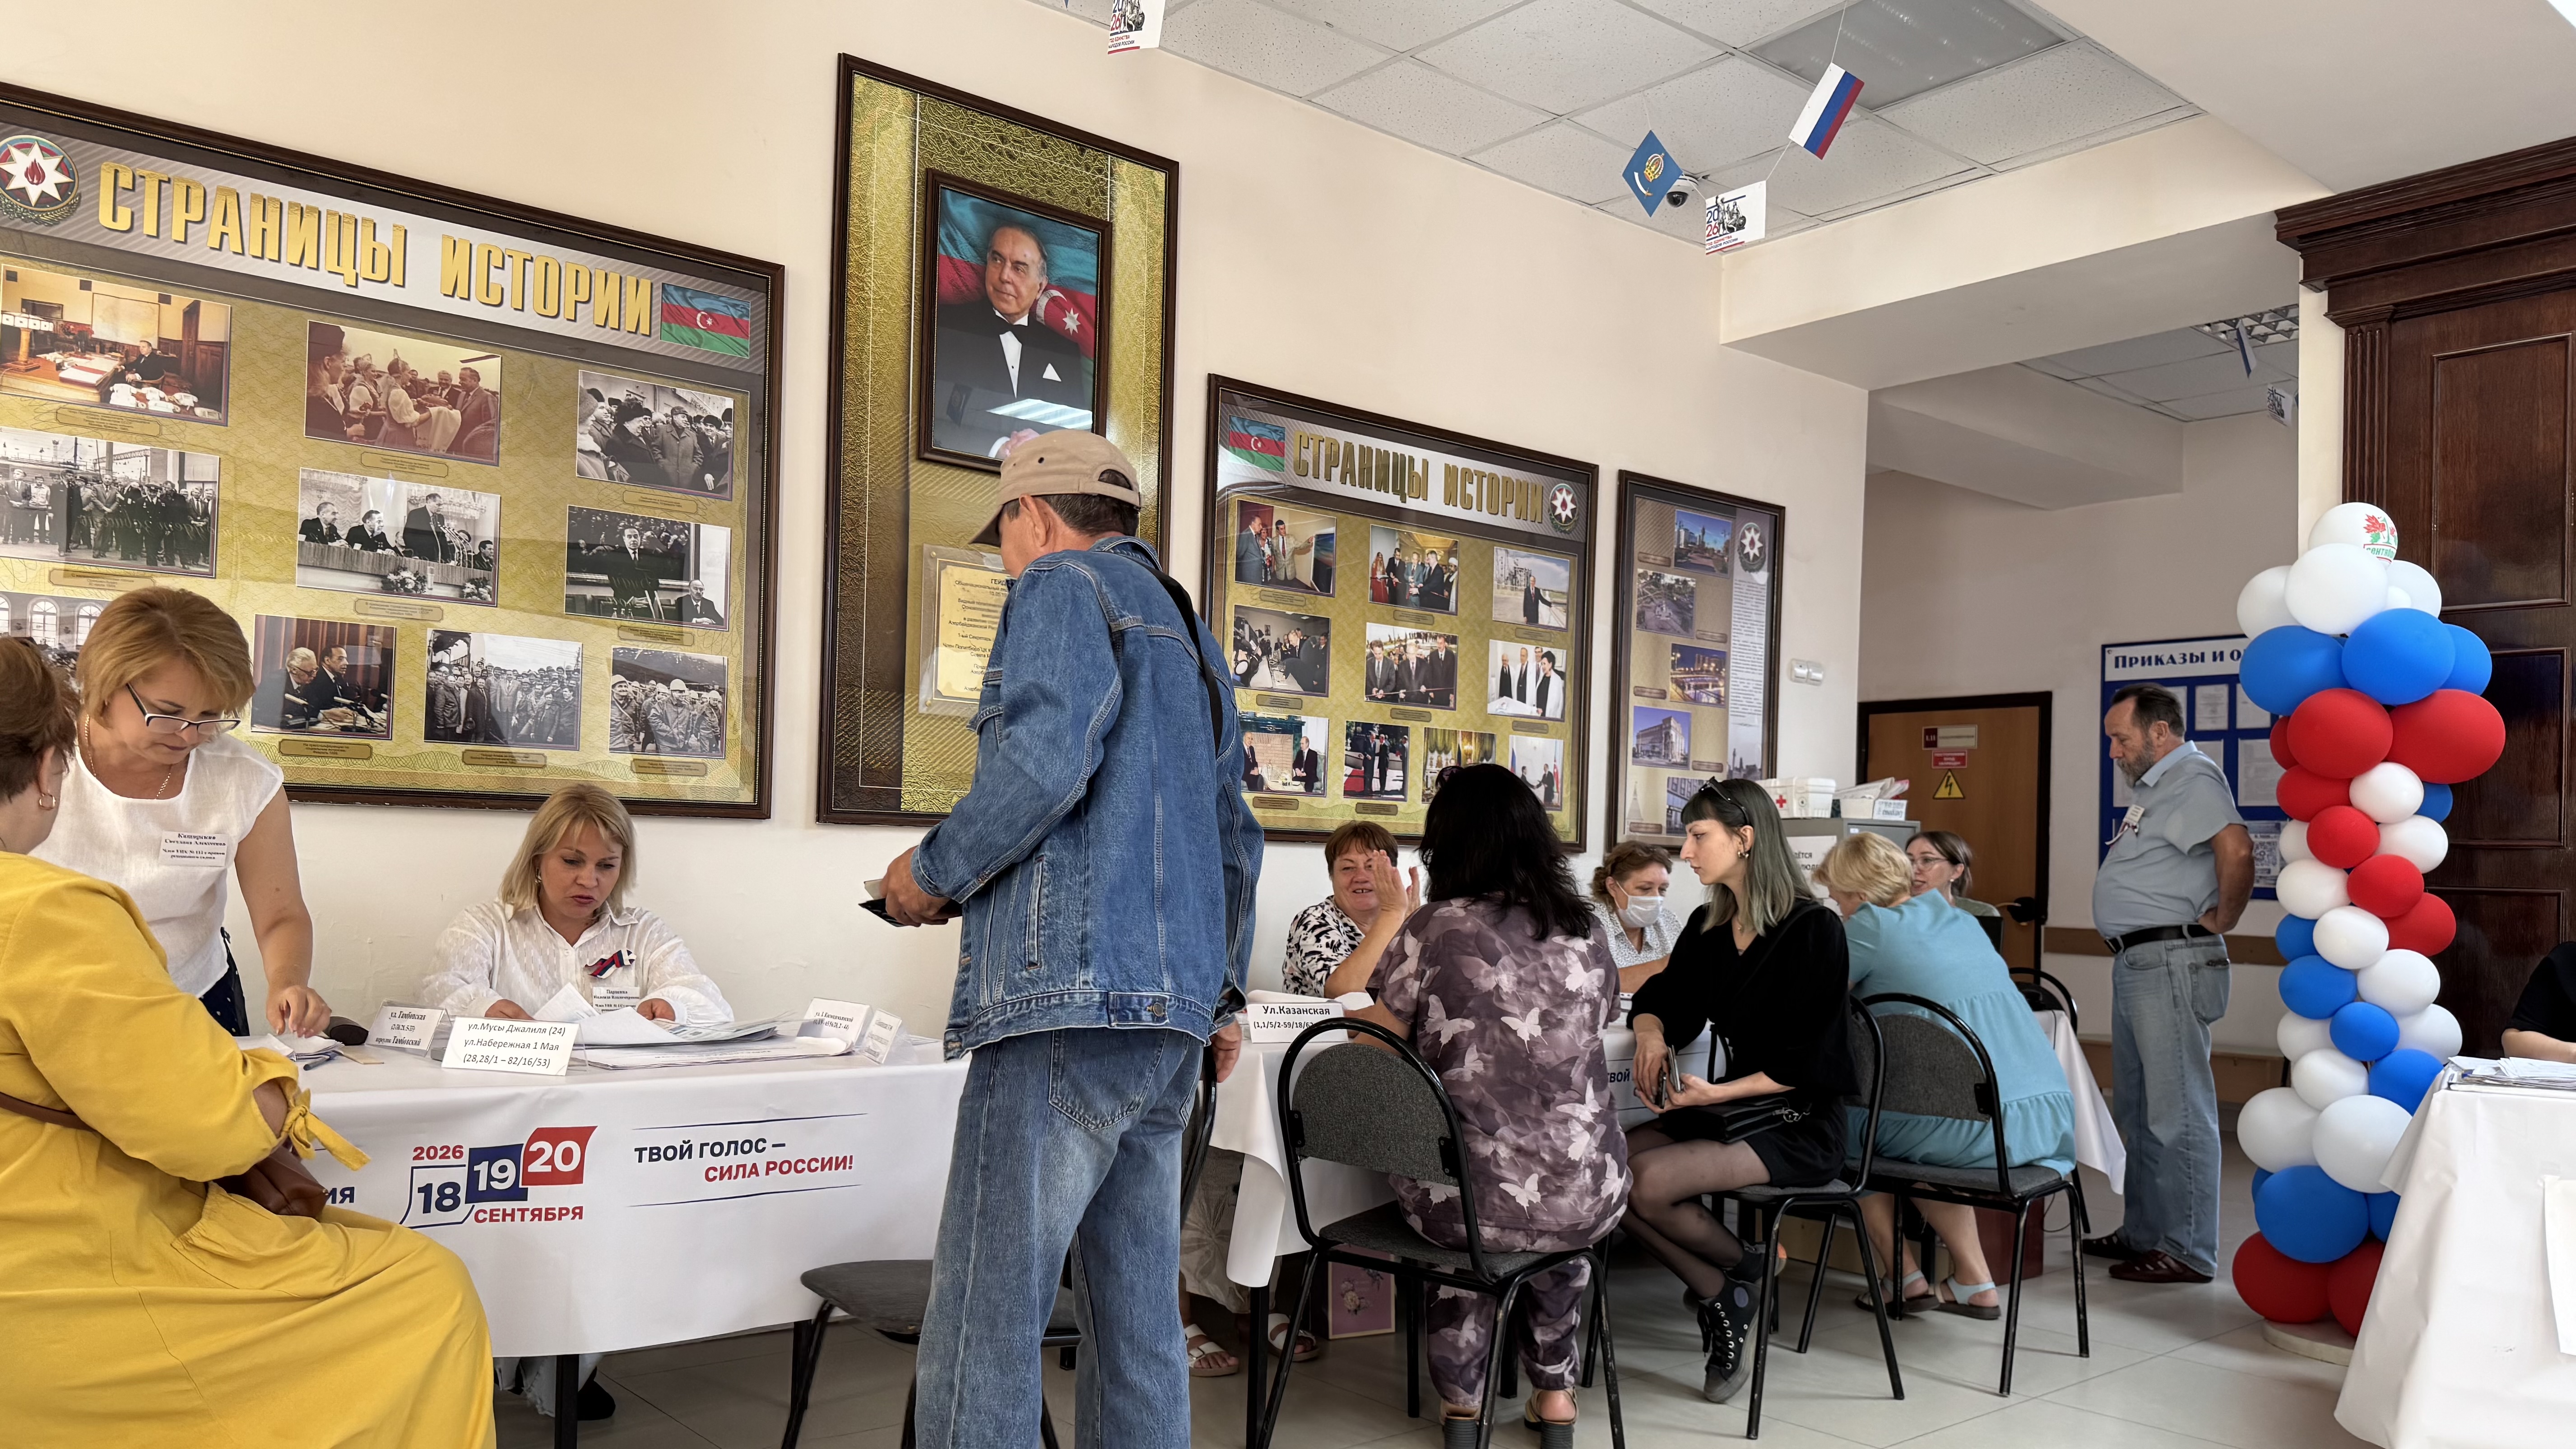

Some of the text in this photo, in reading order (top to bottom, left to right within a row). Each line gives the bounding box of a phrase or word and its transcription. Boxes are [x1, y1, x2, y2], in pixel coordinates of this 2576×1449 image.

[1110, 13, 1121, 31] 26
[1706, 209, 1719, 224] 20
[1706, 222, 1719, 238] 26
[98, 161, 652, 337] СТРАНИЦЫ ИСТОРИИ
[1293, 430, 1543, 524] СТРАНИЦЫ ИСТОРИИ
[2212, 650, 2224, 662] И
[2229, 649, 2245, 662] О
[1262, 1005, 1331, 1016] Ул.Казанская
[468, 1022, 566, 1037] ул.Мусы Джалиля (24)
[464, 1039, 531, 1049] ул.Набережная
[540, 1042, 560, 1051] Мая
[464, 1054, 498, 1064] (28,28/1
[508, 1056, 550, 1068] 82/16/53)
[412, 1145, 464, 1161] 2026
[528, 1141, 581, 1173] 20
[634, 1140, 693, 1163] ТВОЙ
[699, 1138, 767, 1158] ГОЛОС
[473, 1158, 516, 1192] 19
[705, 1155, 854, 1182] СИЛА РОССИИ!
[417, 1183, 461, 1214] 18
[474, 1205, 584, 1224] СЕНТЯБРЯ
